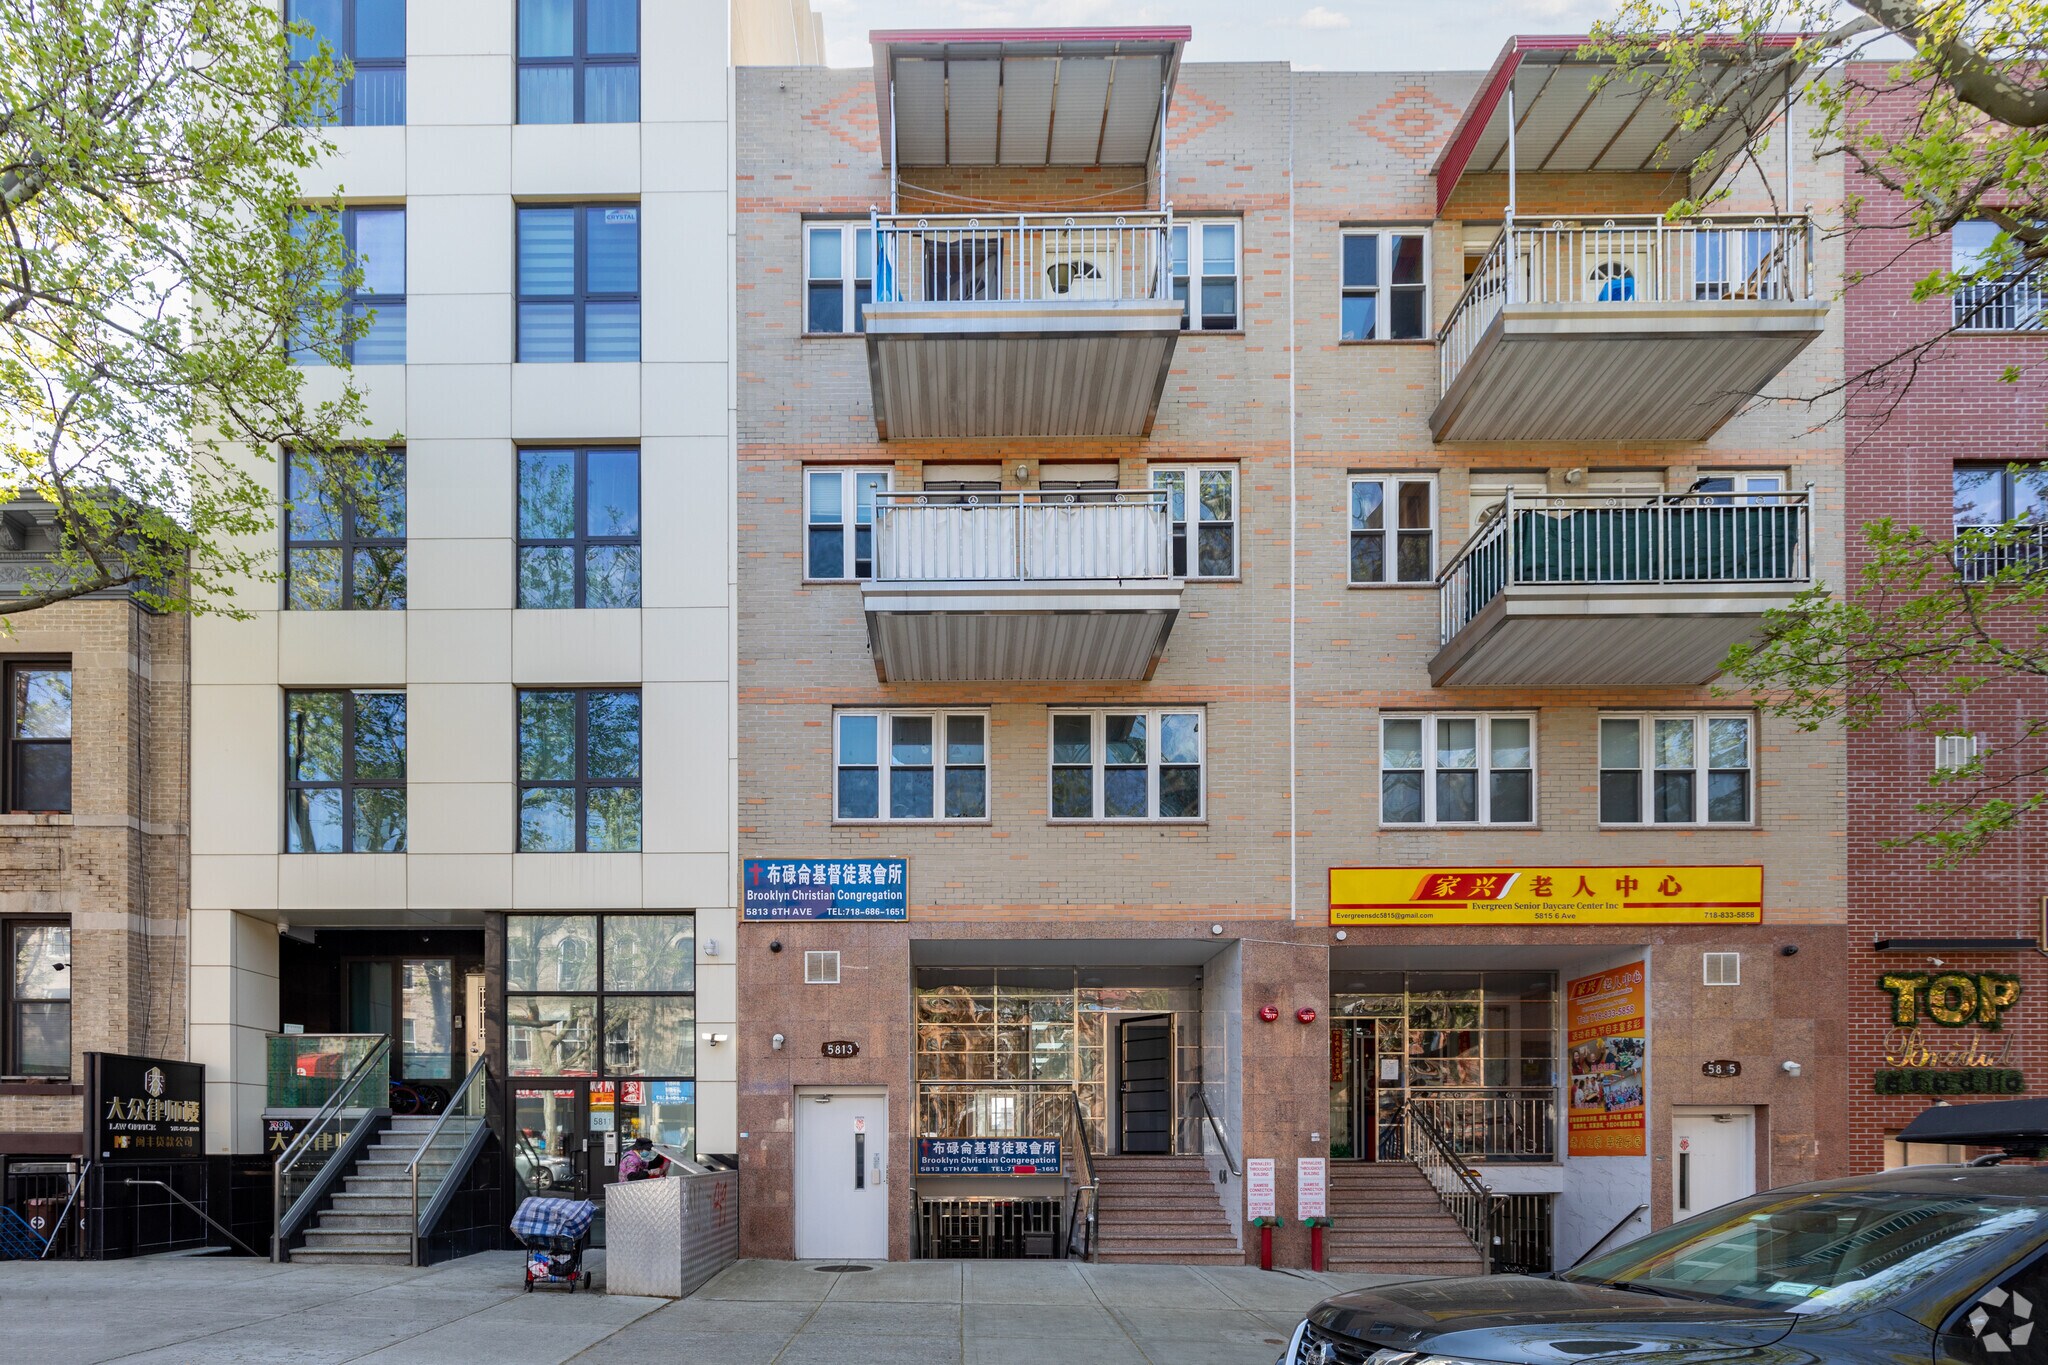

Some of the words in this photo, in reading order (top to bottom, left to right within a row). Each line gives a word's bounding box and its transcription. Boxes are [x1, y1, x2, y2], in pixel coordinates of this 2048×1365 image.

[1431, 875, 1498, 898] 家兴
[1529, 874, 1683, 898] 老人中心
[747, 889, 790, 903] Brooklyn
[792, 889, 835, 901] Christian
[837, 889, 903, 903] Congregation
[1472, 902, 1513, 911] Evergreen
[1514, 902, 1541, 910] Senior
[1542, 902, 1576, 911] Daycare
[1576, 901, 1604, 910] Center
[1605, 901, 1619, 909] Inc
[746, 908, 769, 916] 5813
[771, 908, 790, 916] 6TH
[792, 908, 813, 916] AVE
[827, 908, 905, 916] TEL:718-686-1651
[1336, 912, 1434, 920] Evergreensdc5815@gmail.com
[1534, 912, 1553, 920] 5815
[1554, 912, 1560, 920] 6
[1561, 912, 1576, 920] Ave
[1704, 911, 1755, 919] 718-833-5858
[1881, 973, 2021, 1025] TOP
[827, 1044, 853, 1055] 5813
[1883, 1026, 2019, 1067] Bridal
[109, 1122, 127, 1131] LAW
[127, 1122, 157, 1131] OFFICE
[921, 1156, 959, 1165] Brooklyn
[961, 1156, 998, 1164] Christian
[1000, 1156, 1057, 1165] Congregation
